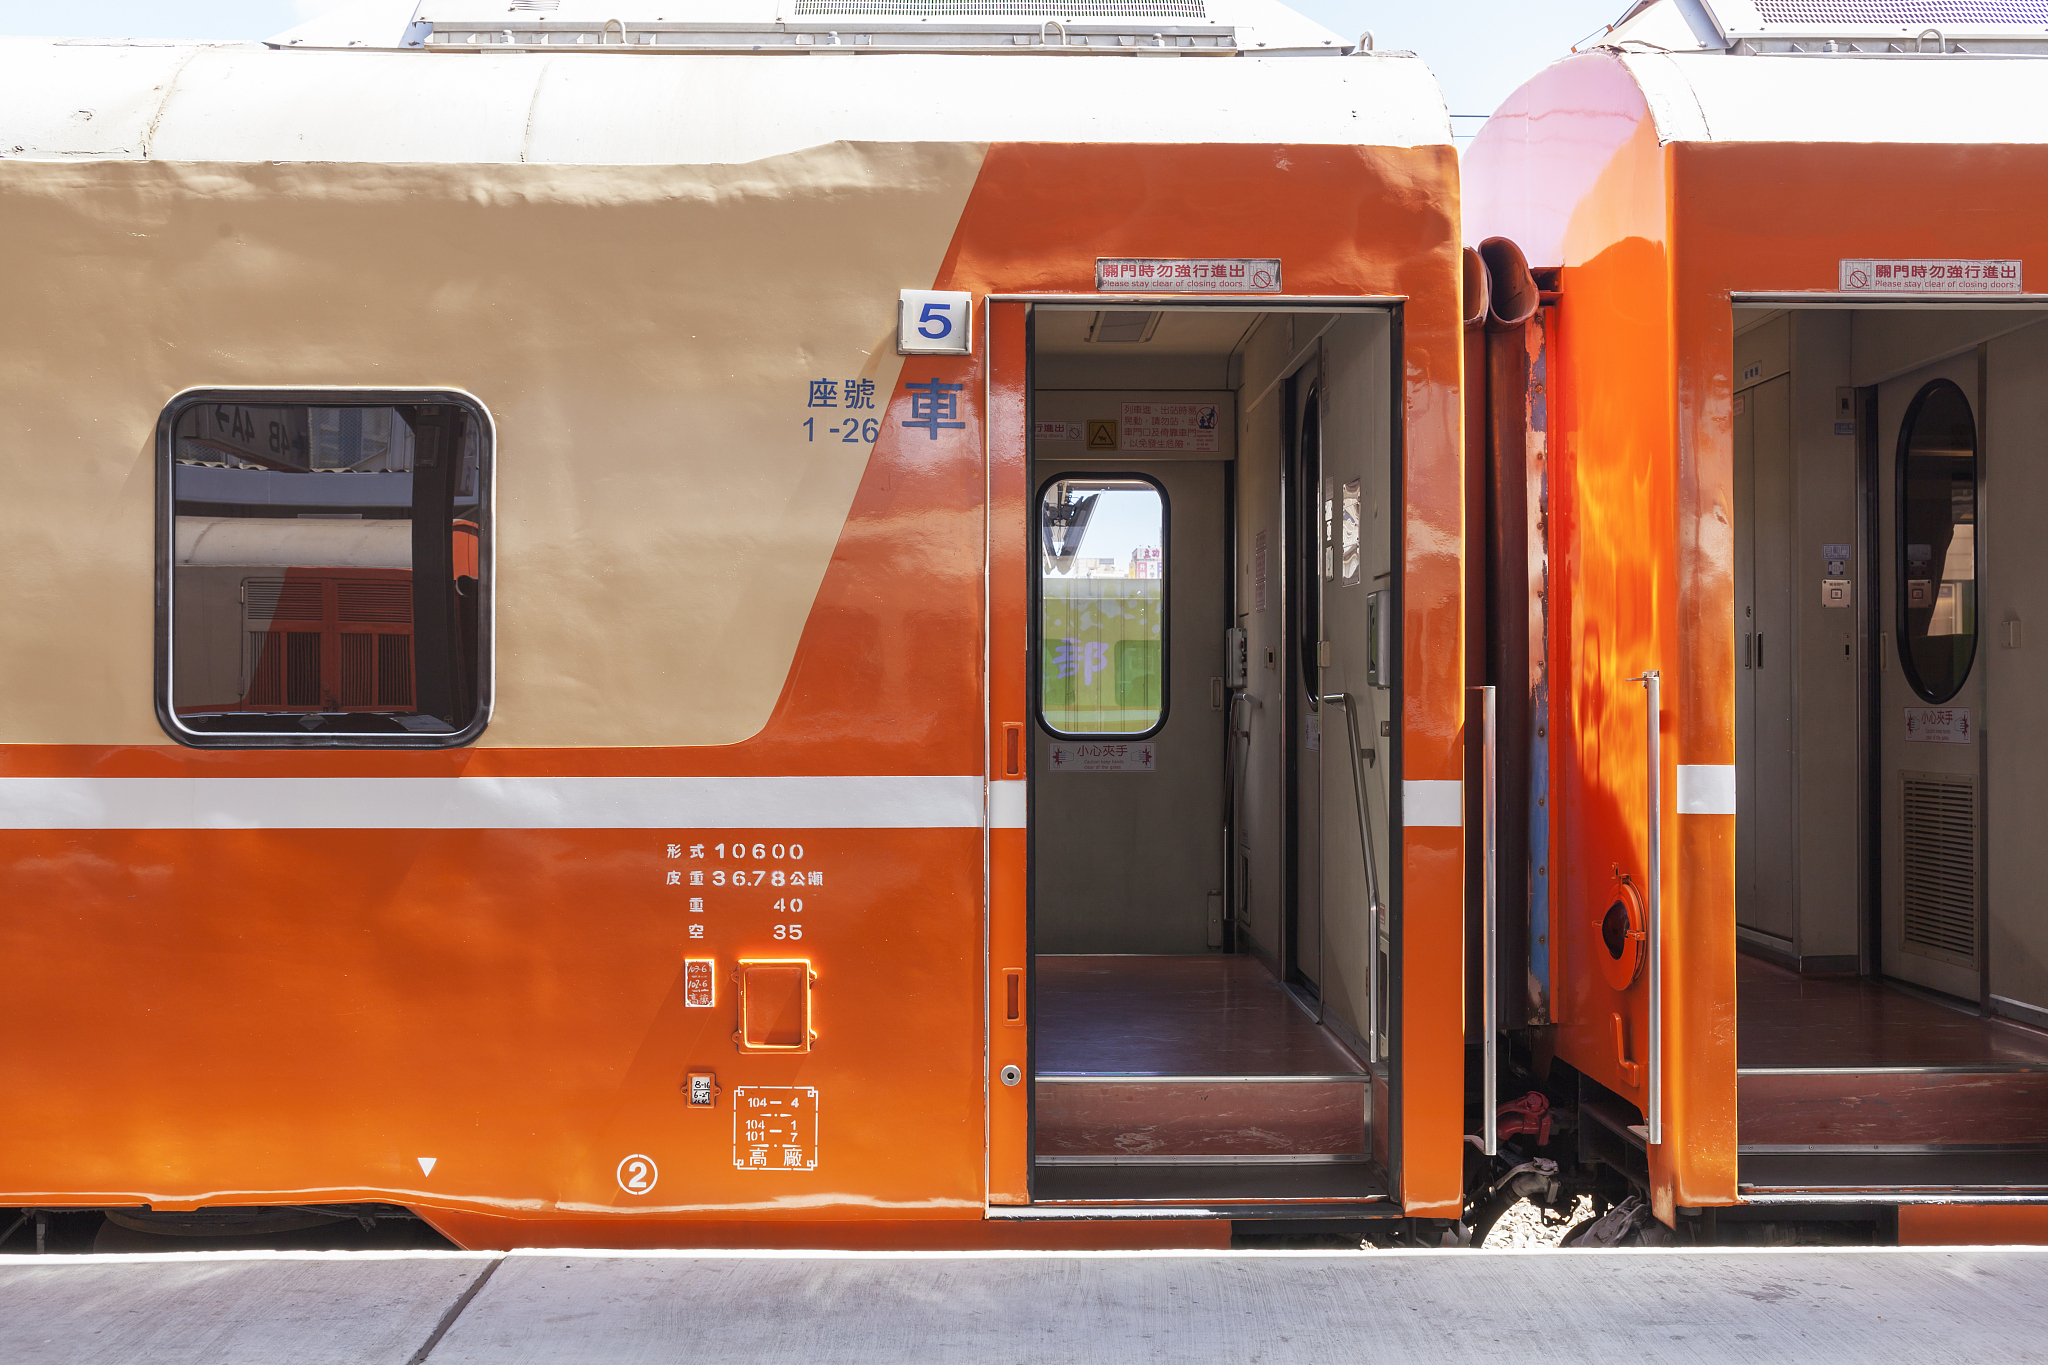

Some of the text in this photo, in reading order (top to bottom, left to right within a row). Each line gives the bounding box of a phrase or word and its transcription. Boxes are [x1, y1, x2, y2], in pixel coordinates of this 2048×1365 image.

[1102, 264, 1245, 278] 關門時勿強行進出
[1875, 264, 2016, 279] 關門時勿強行進出
[1131, 280, 1150, 289] stay
[1175, 279, 1185, 287] of
[1187, 280, 1216, 289] closing
[1875, 280, 2015, 289] Please stay clear of closing doors.
[917, 303, 952, 339] 5
[807, 377, 876, 409] 座號
[902, 377, 966, 440] 車
[802, 417, 879, 443] 1-26
[1921, 710, 1953, 725] 小心夾手
[1077, 744, 1128, 757] 小心夾手
[667, 843, 804, 860] 形式 10600
[666, 870, 704, 886] 皮重
[689, 897, 803, 913] 重 40
[688, 923, 803, 940] 空 35
[745, 1119, 766, 1130] 104
[745, 1131, 798, 1142] 101 7
[749, 1147, 803, 1167] 高廠
